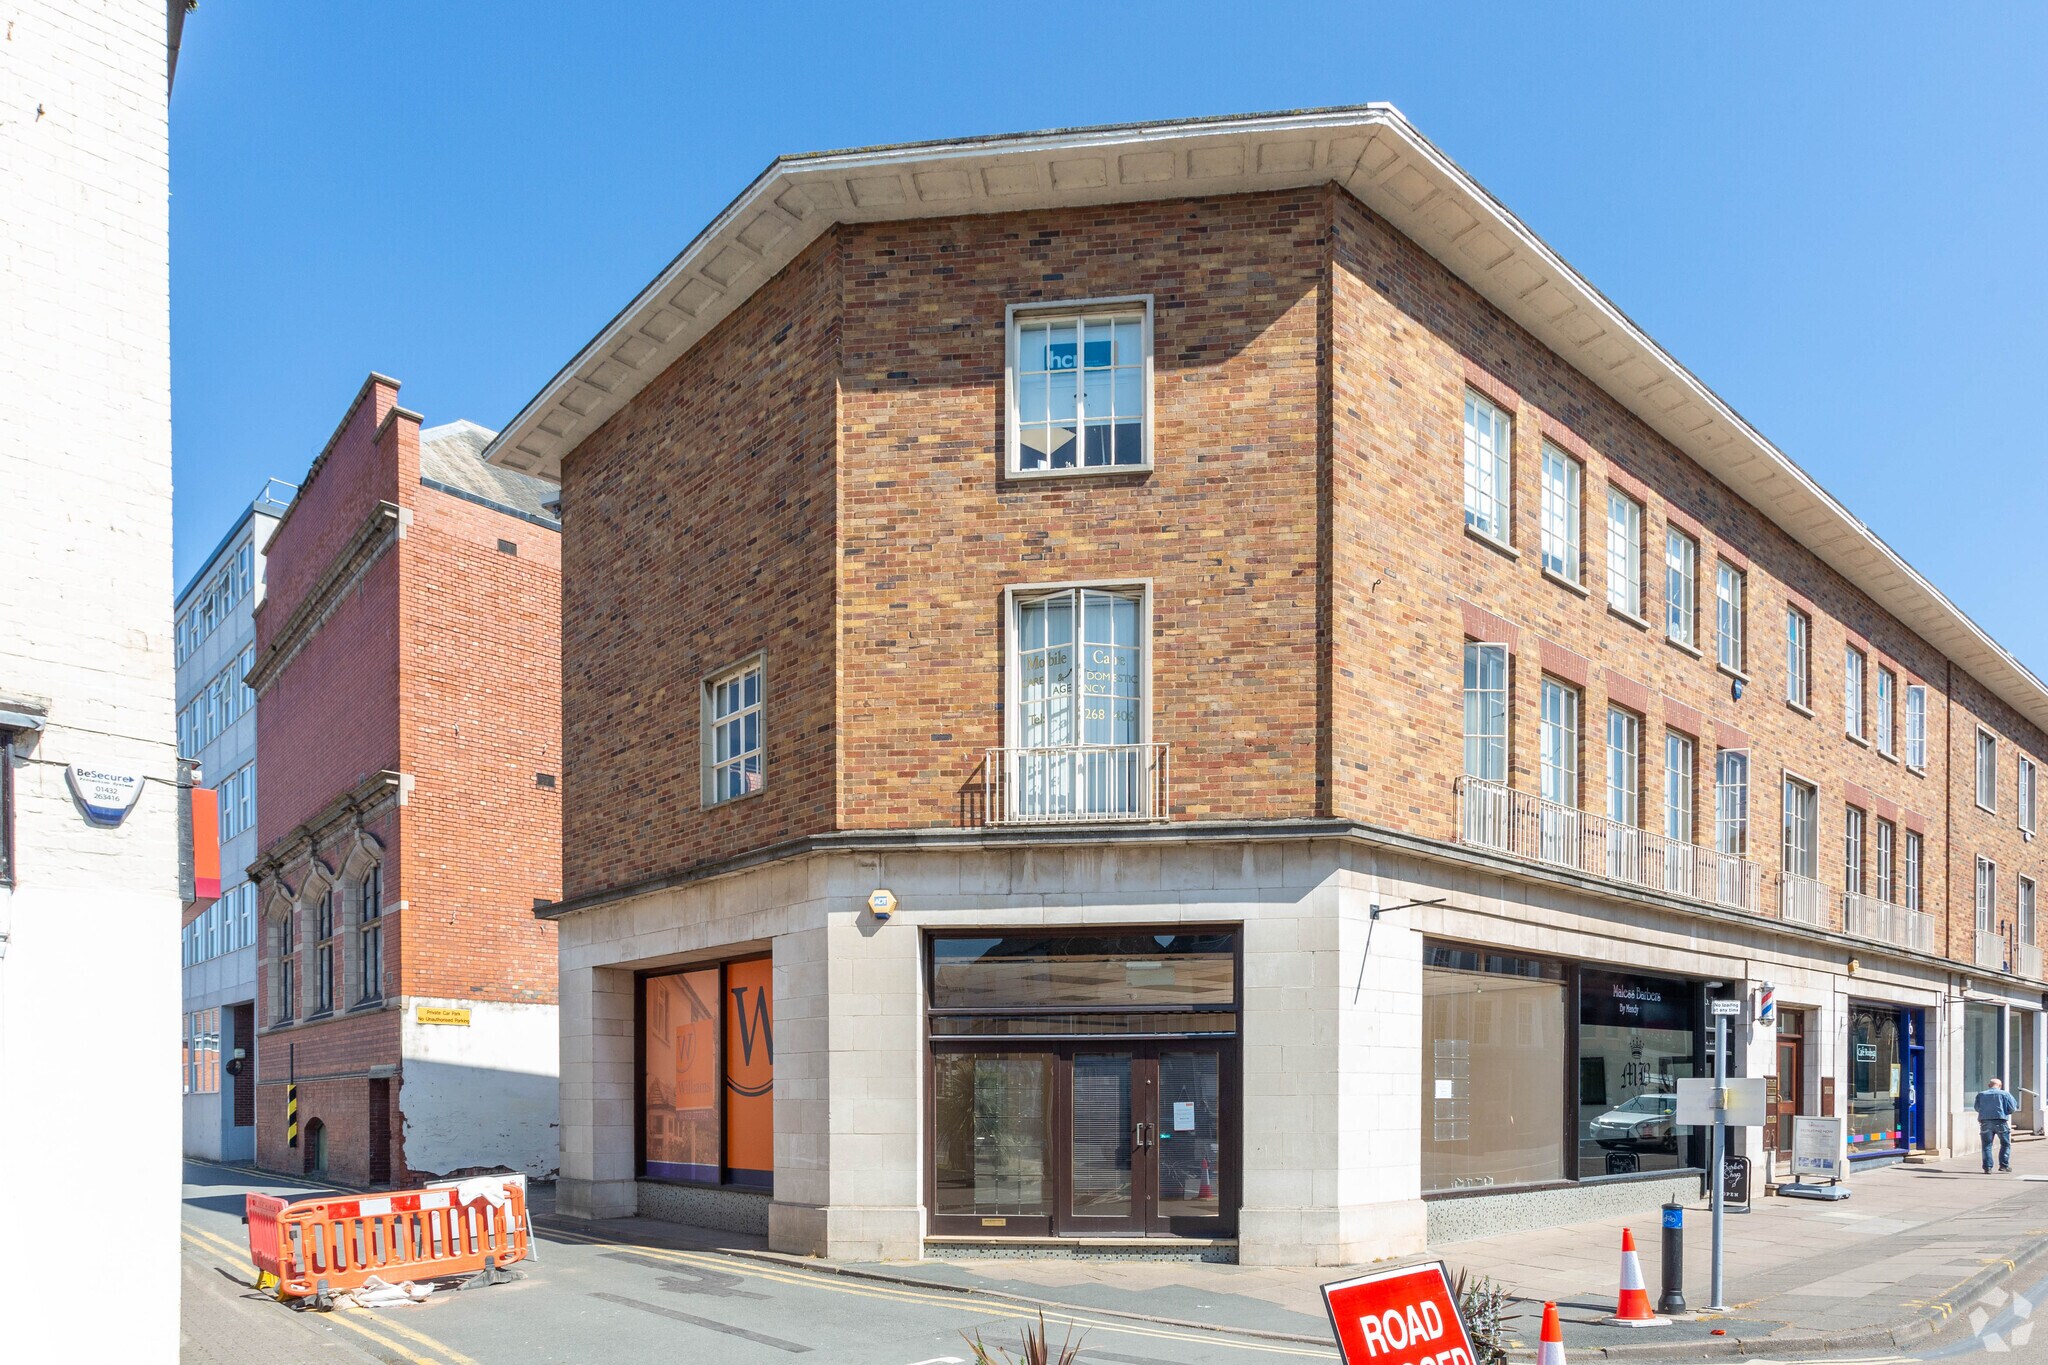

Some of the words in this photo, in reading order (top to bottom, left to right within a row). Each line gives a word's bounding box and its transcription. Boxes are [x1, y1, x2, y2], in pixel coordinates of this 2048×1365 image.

[1027, 650, 1067, 671] Mobile
[1093, 650, 1126, 666] Care
[1021, 676, 1045, 689] CARE
[1058, 673, 1065, 682] &
[1087, 672, 1138, 684] DOMESTIC
[1029, 713, 1046, 726] Tel:
[1085, 708, 1105, 720] 268
[77, 768, 128, 783] BeSecure
[93, 793, 120, 802] 263416
[95, 786, 118, 795] 01432
[1360, 1300, 1443, 1357] ROAD
